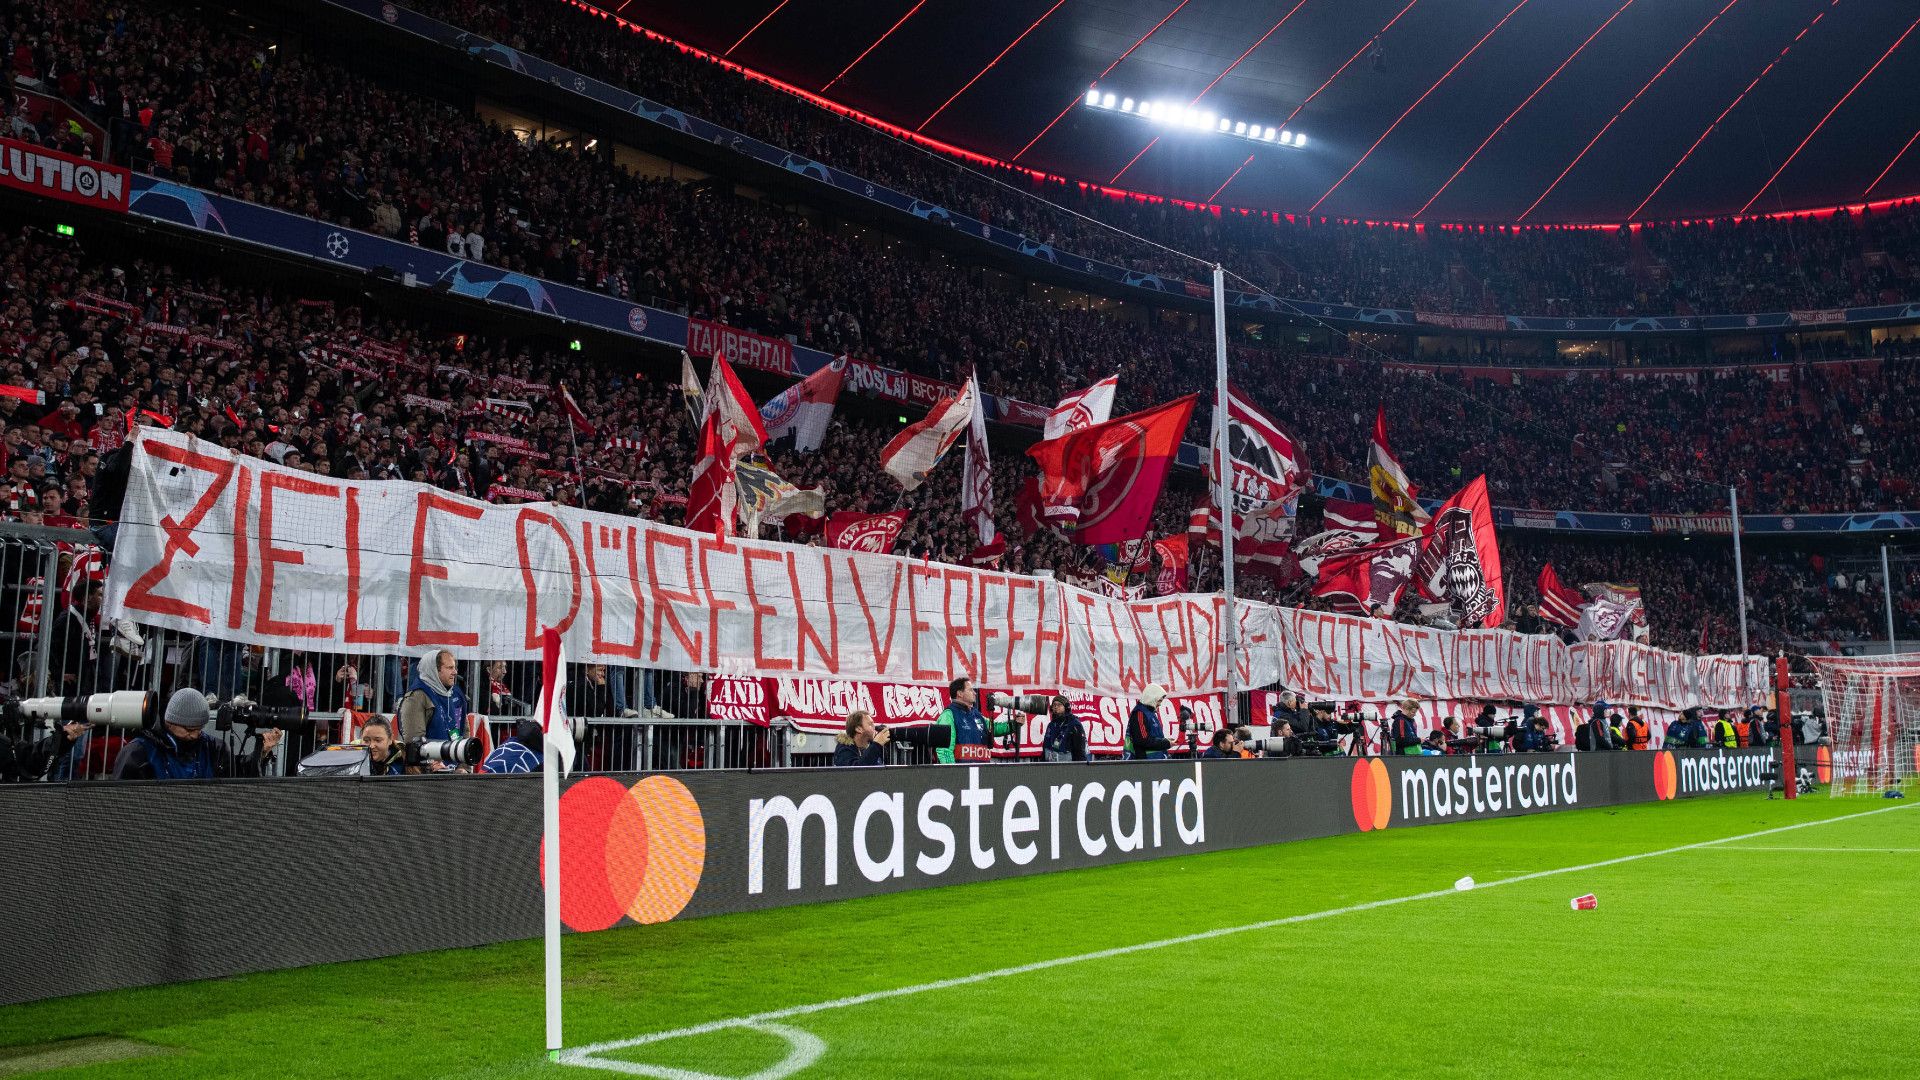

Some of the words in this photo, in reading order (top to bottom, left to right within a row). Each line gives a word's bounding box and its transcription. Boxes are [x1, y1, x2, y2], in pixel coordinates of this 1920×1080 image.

[691, 322, 790, 374] TAUBERTAL
[911, 378, 937, 402] BFC
[124, 439, 484, 647] ZIELE
[516, 507, 839, 674] DÜRFEN
[848, 556, 1100, 689] VERFEHLT
[1106, 596, 1250, 694] WERDEN
[1276, 604, 1376, 698] WERTE
[708, 680, 765, 706] LAND
[1401, 752, 1578, 819] mastercard
[1681, 747, 1775, 793] mastercard
[748, 761, 1206, 895] mastercard
